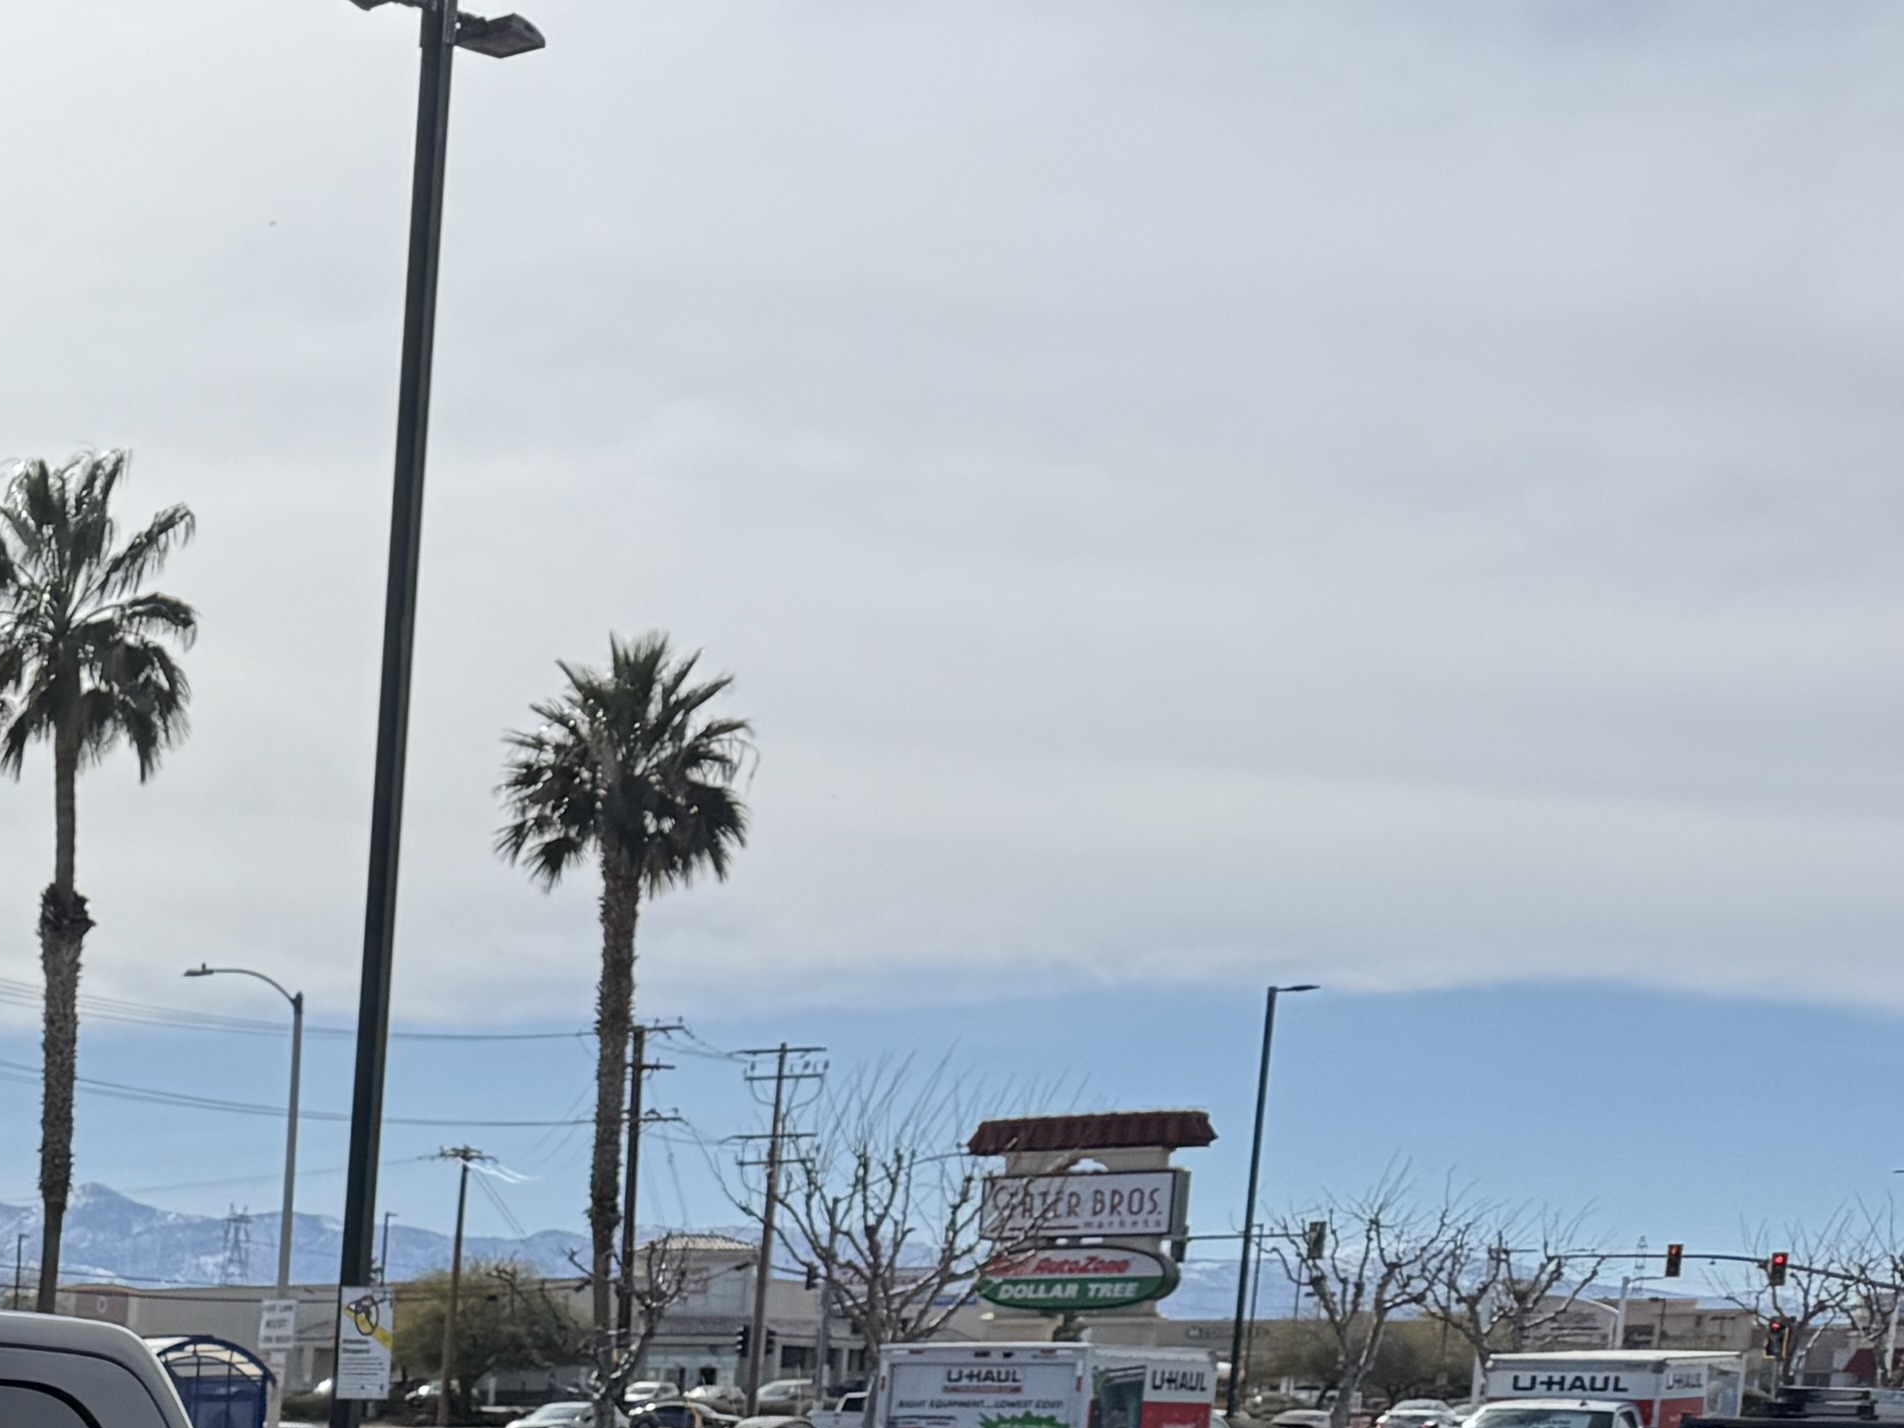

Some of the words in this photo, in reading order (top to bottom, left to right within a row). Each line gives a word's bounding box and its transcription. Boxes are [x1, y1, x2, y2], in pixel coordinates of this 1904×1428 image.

[1092, 1187, 1163, 1217] BROS.
[1032, 1256, 1131, 1274] AutoZone
[997, 1283, 1078, 1300] DOLLAR
[1087, 1282, 1139, 1298] TREE
[946, 1369, 1022, 1383] U-HAUL
[1151, 1370, 1208, 1392] U-HAUL
[1512, 1374, 1629, 1393] U-HAUL
